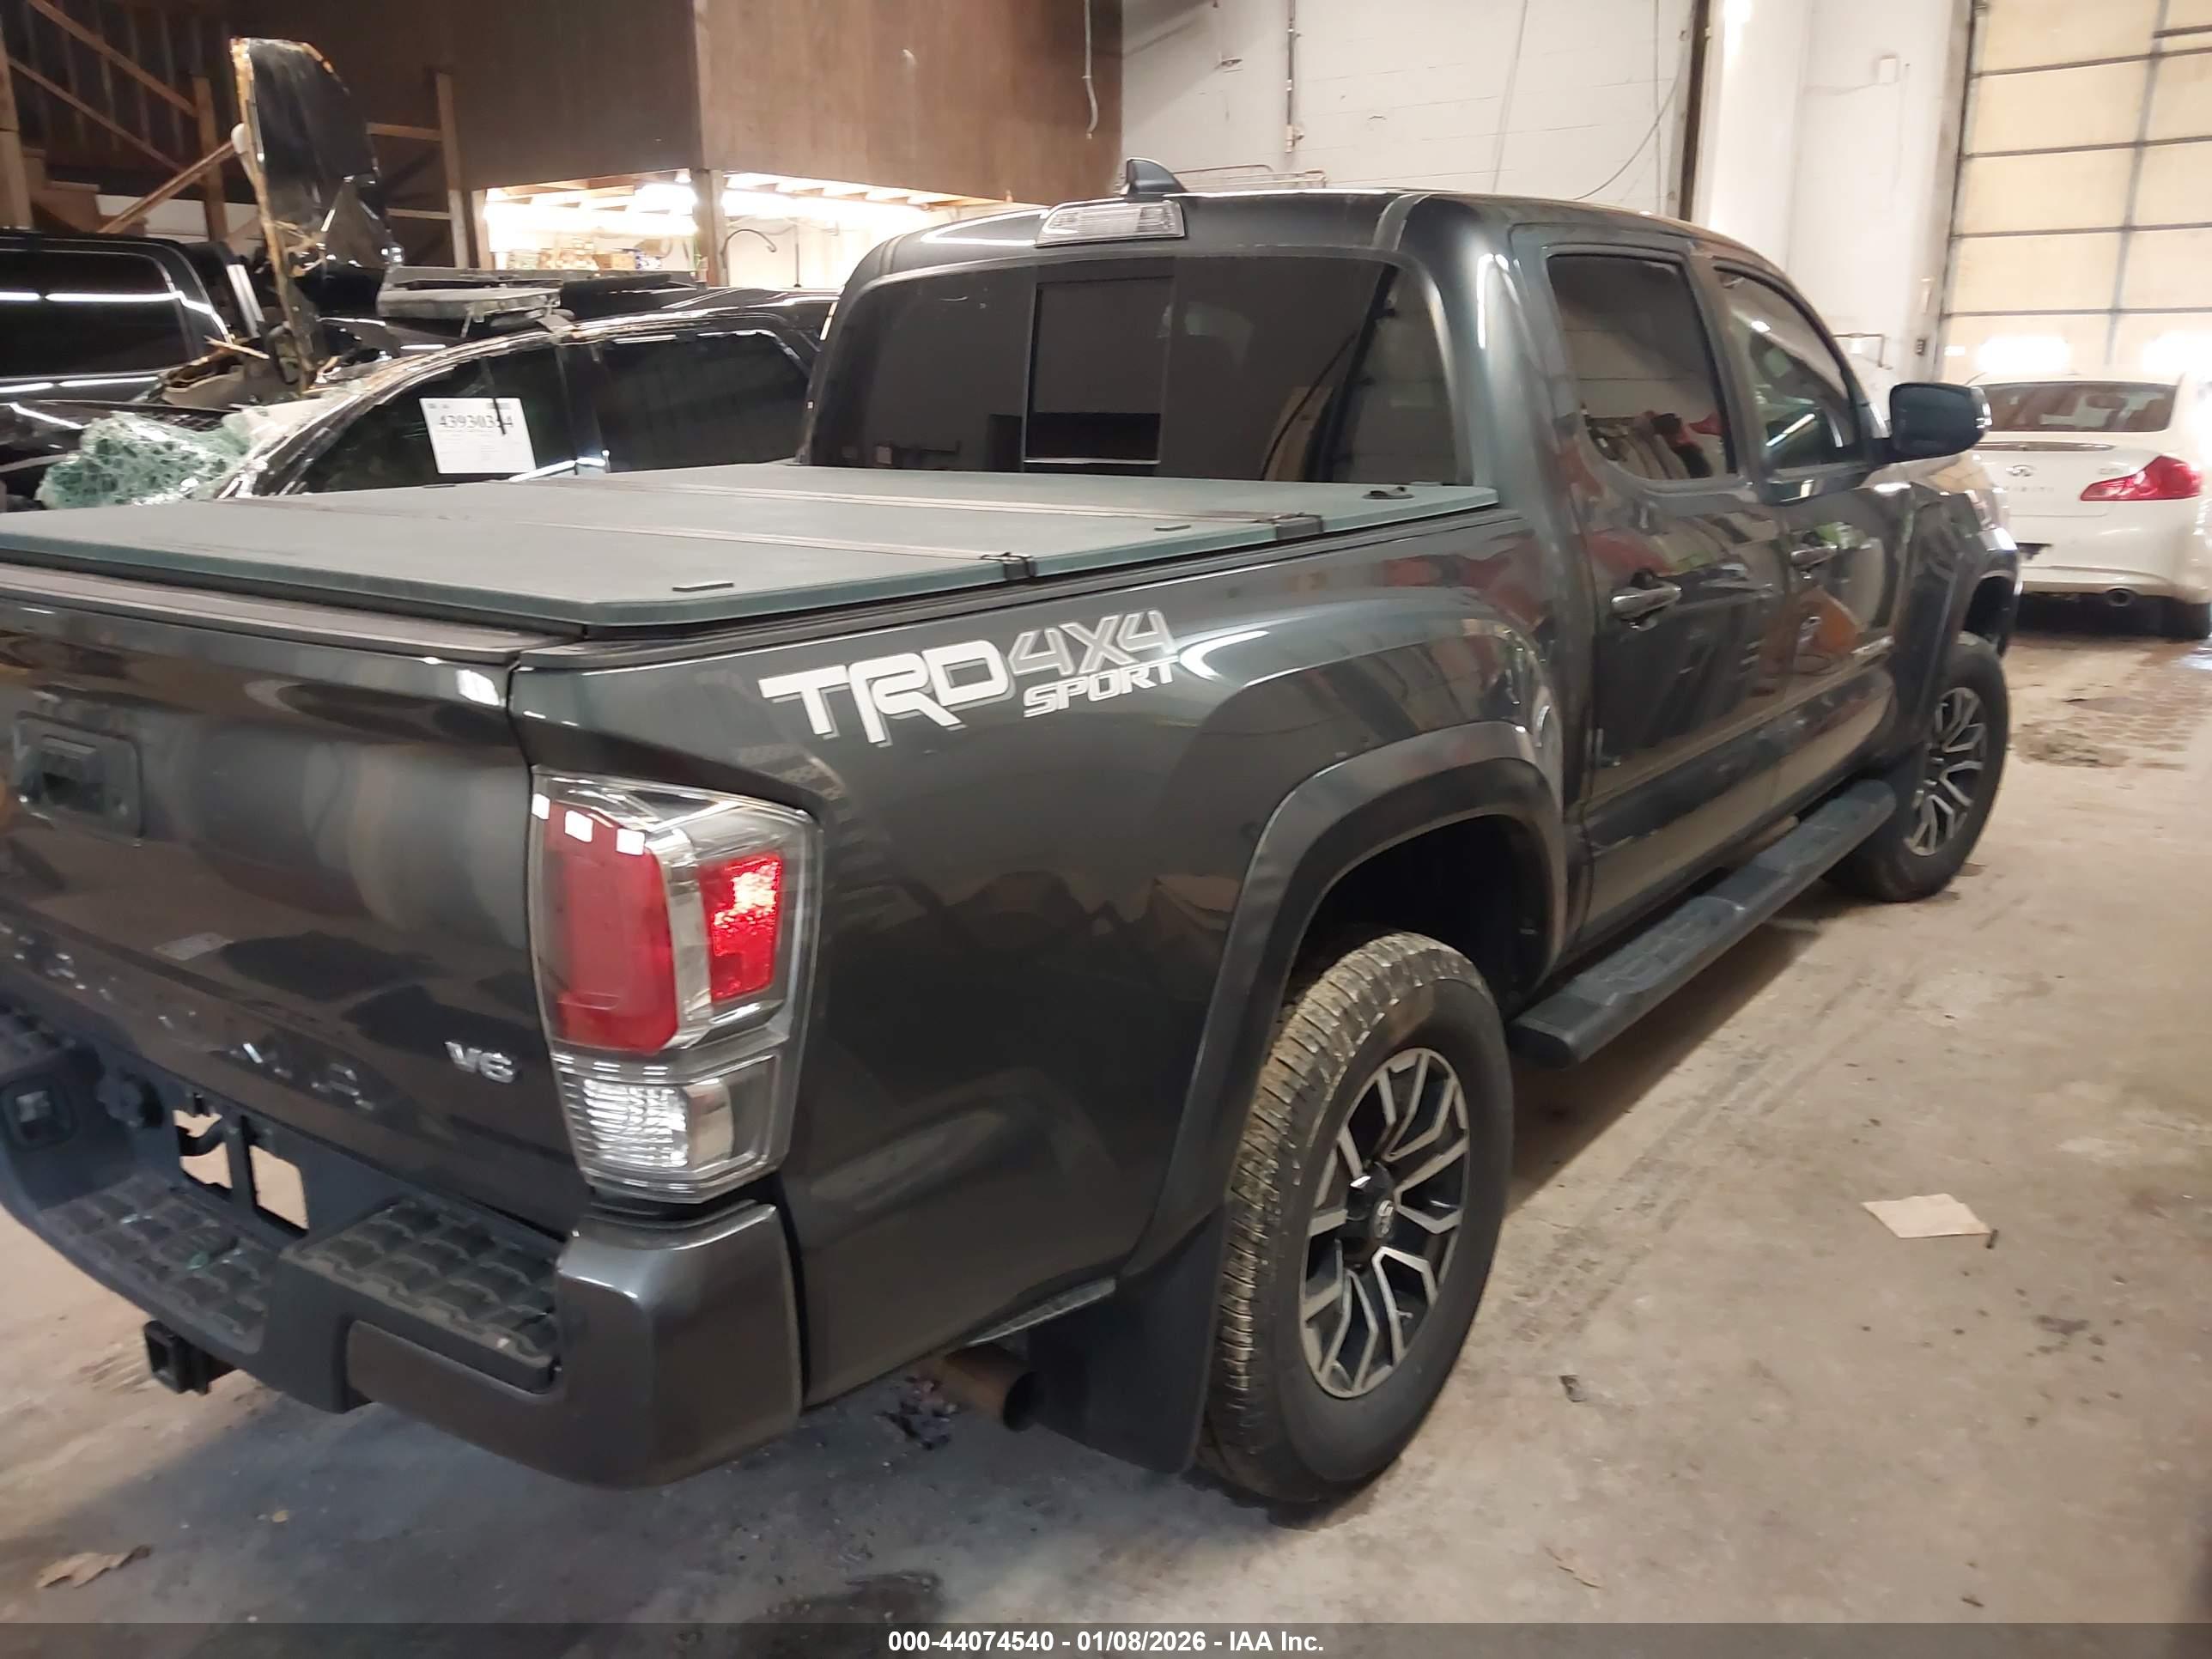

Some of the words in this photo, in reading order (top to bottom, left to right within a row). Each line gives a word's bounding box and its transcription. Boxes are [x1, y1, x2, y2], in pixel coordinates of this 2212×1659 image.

[758, 639, 1017, 747] TRD
[1007, 610, 1176, 678] 4X4
[1023, 654, 1178, 718] SPORT
[444, 1041, 514, 1084] V6
